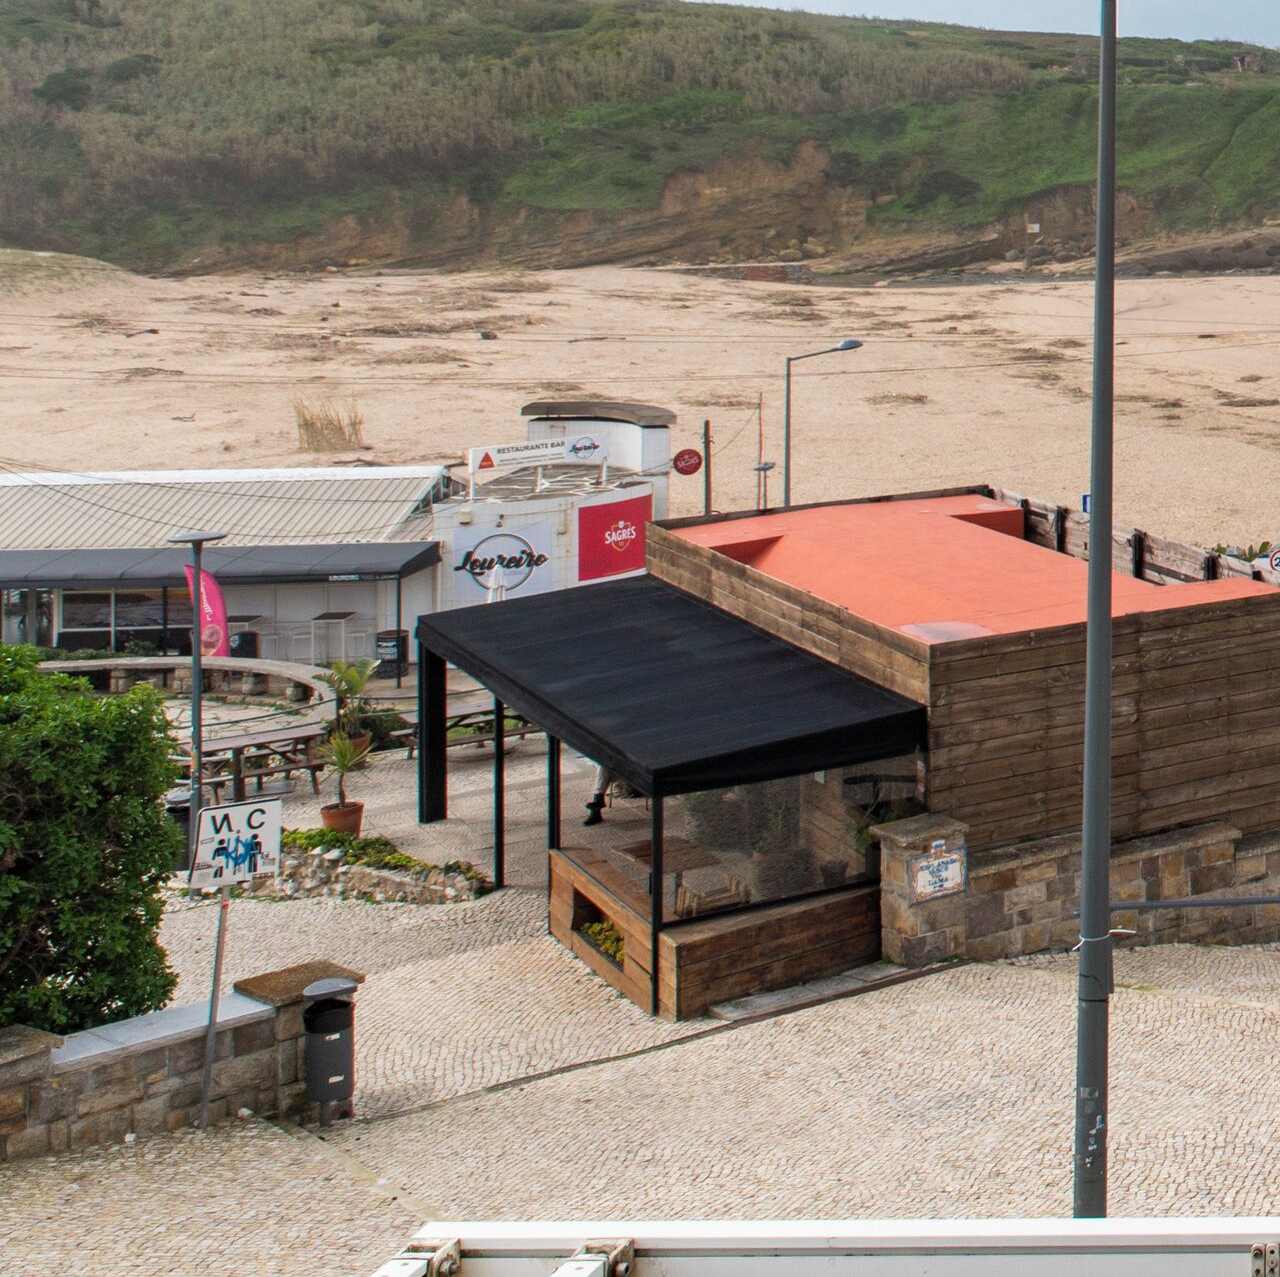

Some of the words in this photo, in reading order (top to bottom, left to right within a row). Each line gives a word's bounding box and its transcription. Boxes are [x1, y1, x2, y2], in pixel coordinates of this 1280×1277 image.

[496, 443, 549, 454] RESTAURANTE
[550, 441, 566, 449] BAR
[604, 526, 637, 545] SAGRES
[454, 549, 549, 576] Loureiro
